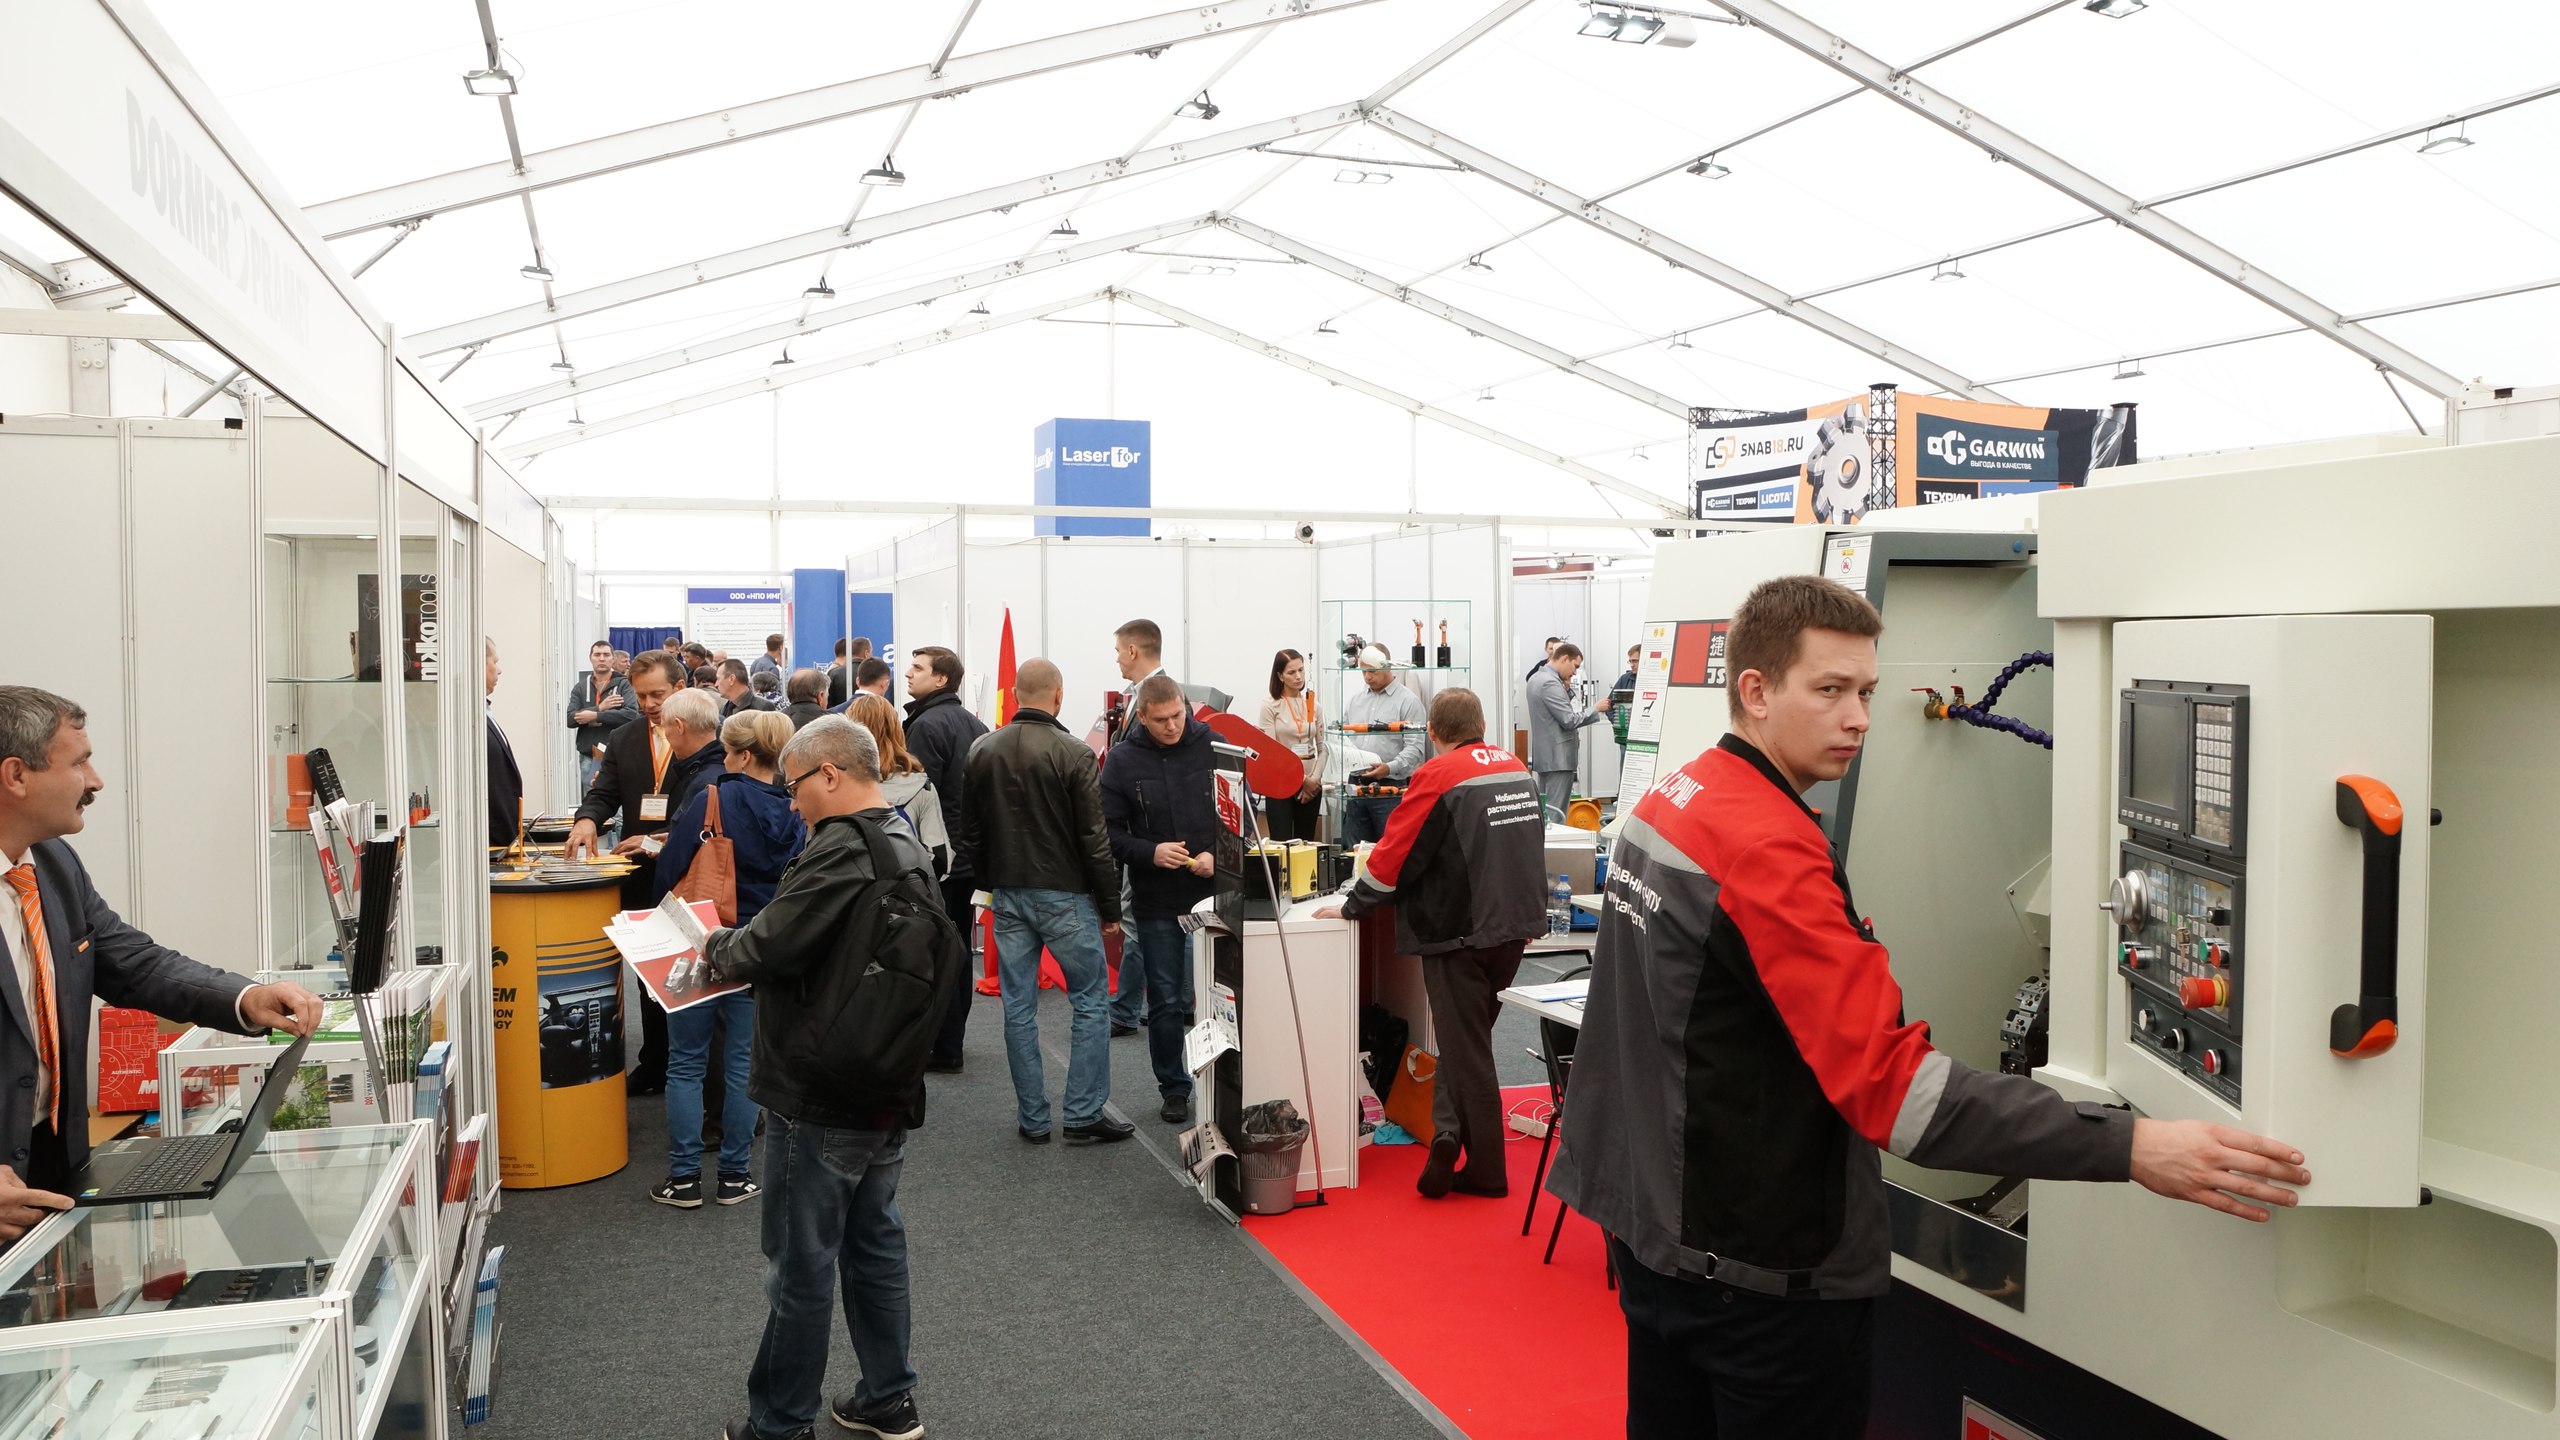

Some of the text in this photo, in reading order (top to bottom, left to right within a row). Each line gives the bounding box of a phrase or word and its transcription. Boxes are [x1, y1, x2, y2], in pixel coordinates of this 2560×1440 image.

[126, 86, 232, 280] DORMER
[1740, 436, 1804, 457] SNAB18.RU
[1969, 438, 2045, 459] GARWIN
[1970, 460, 1996, 469] ВЫГОДА
[2002, 462, 2032, 470] КАЧЕСТВЕ
[729, 592, 746, 600] ООО
[1494, 791, 1531, 803] Мобильные
[1486, 804, 1522, 817] расточные
